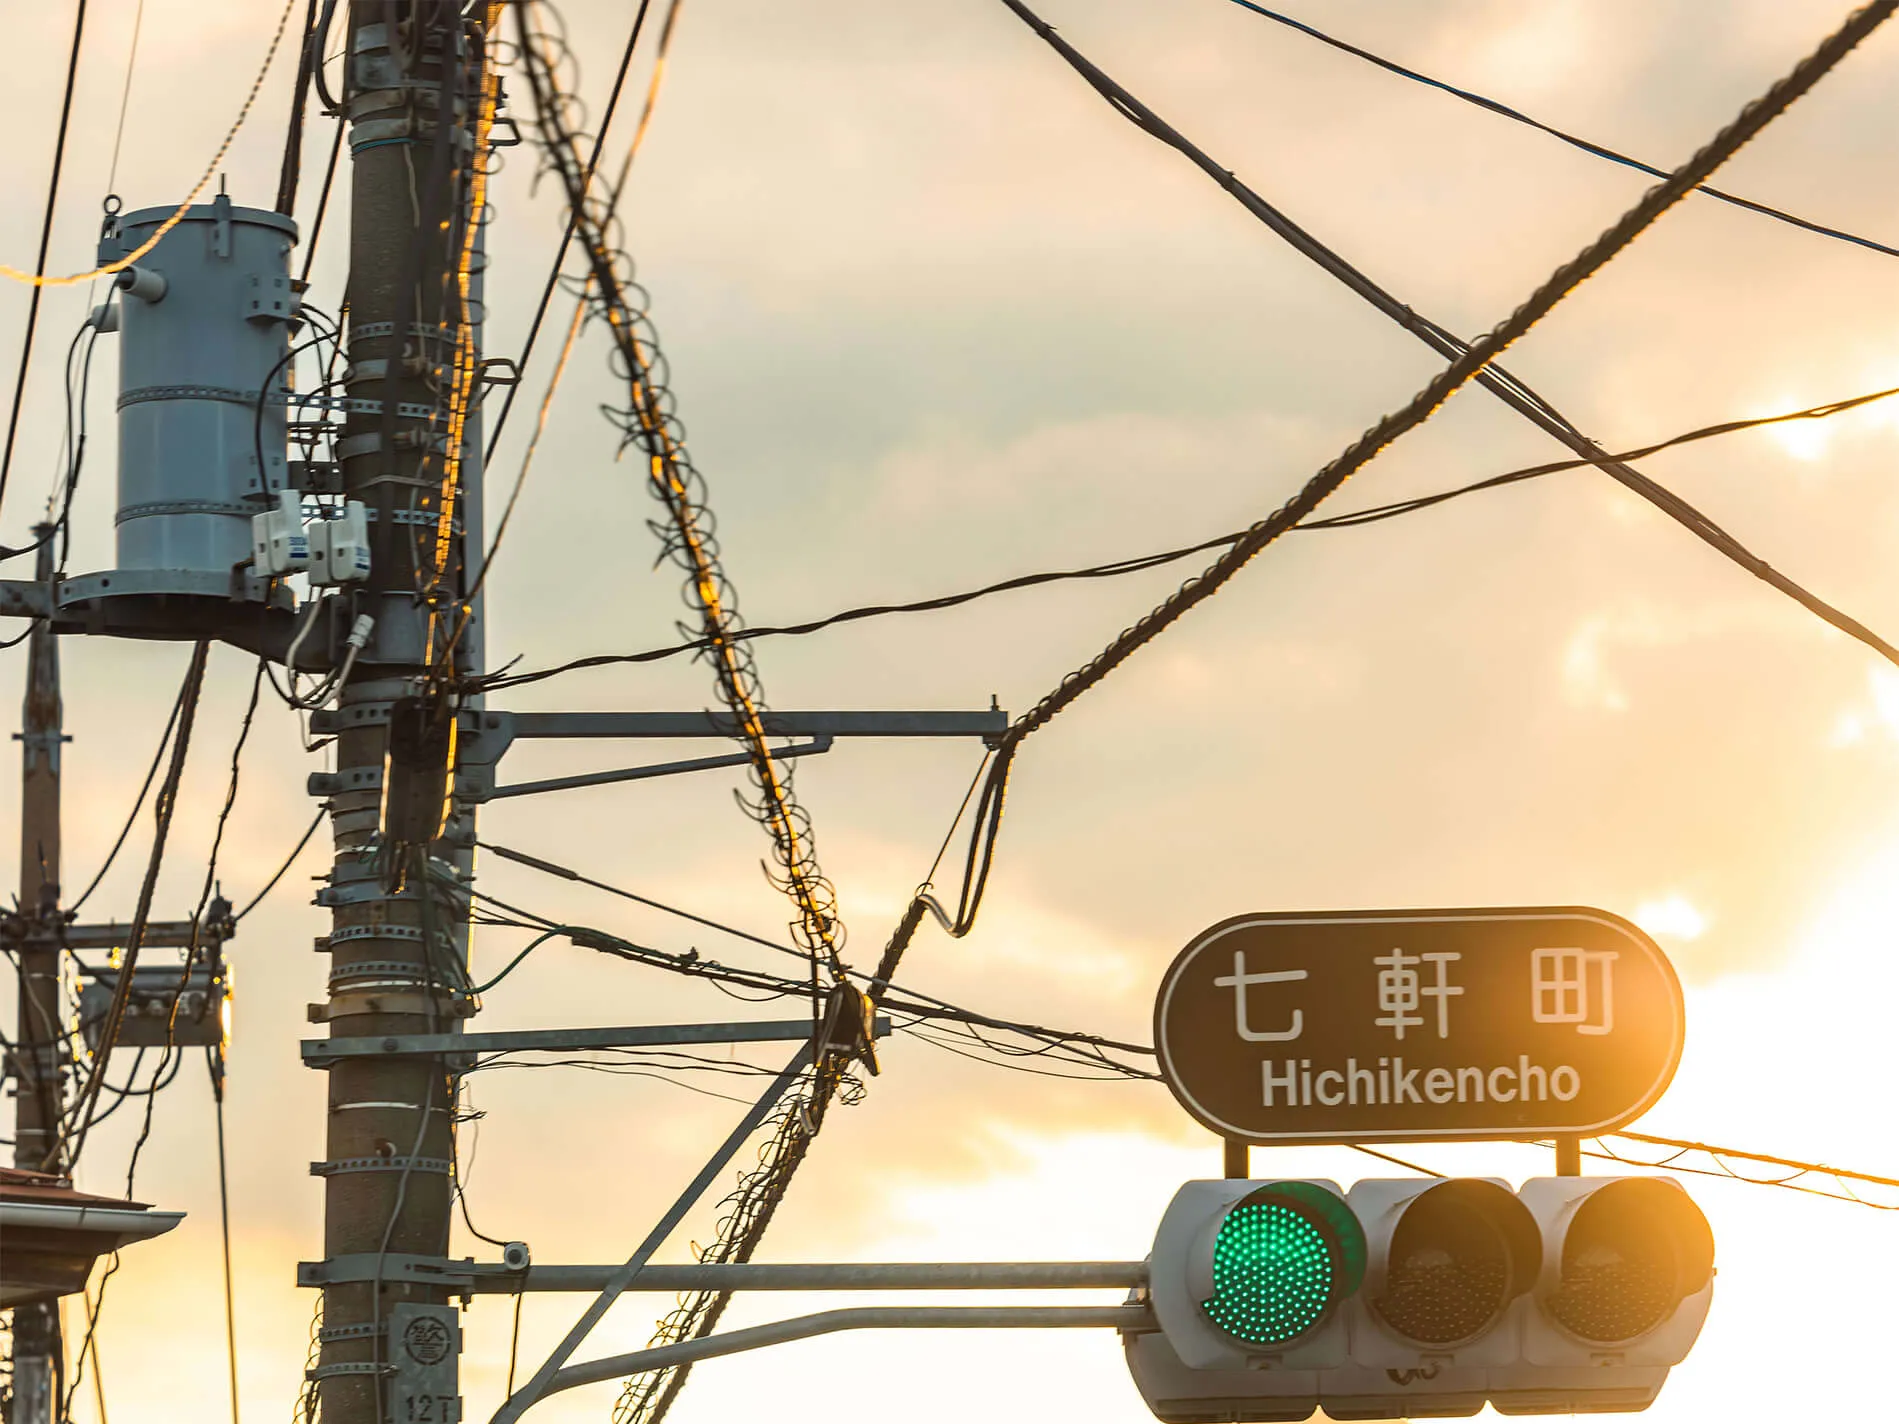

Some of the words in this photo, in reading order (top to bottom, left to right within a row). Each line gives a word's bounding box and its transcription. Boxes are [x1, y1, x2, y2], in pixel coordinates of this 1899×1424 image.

[1213, 947, 1620, 1042] 七軒町
[1261, 1055, 1581, 1107] Hichikencho
